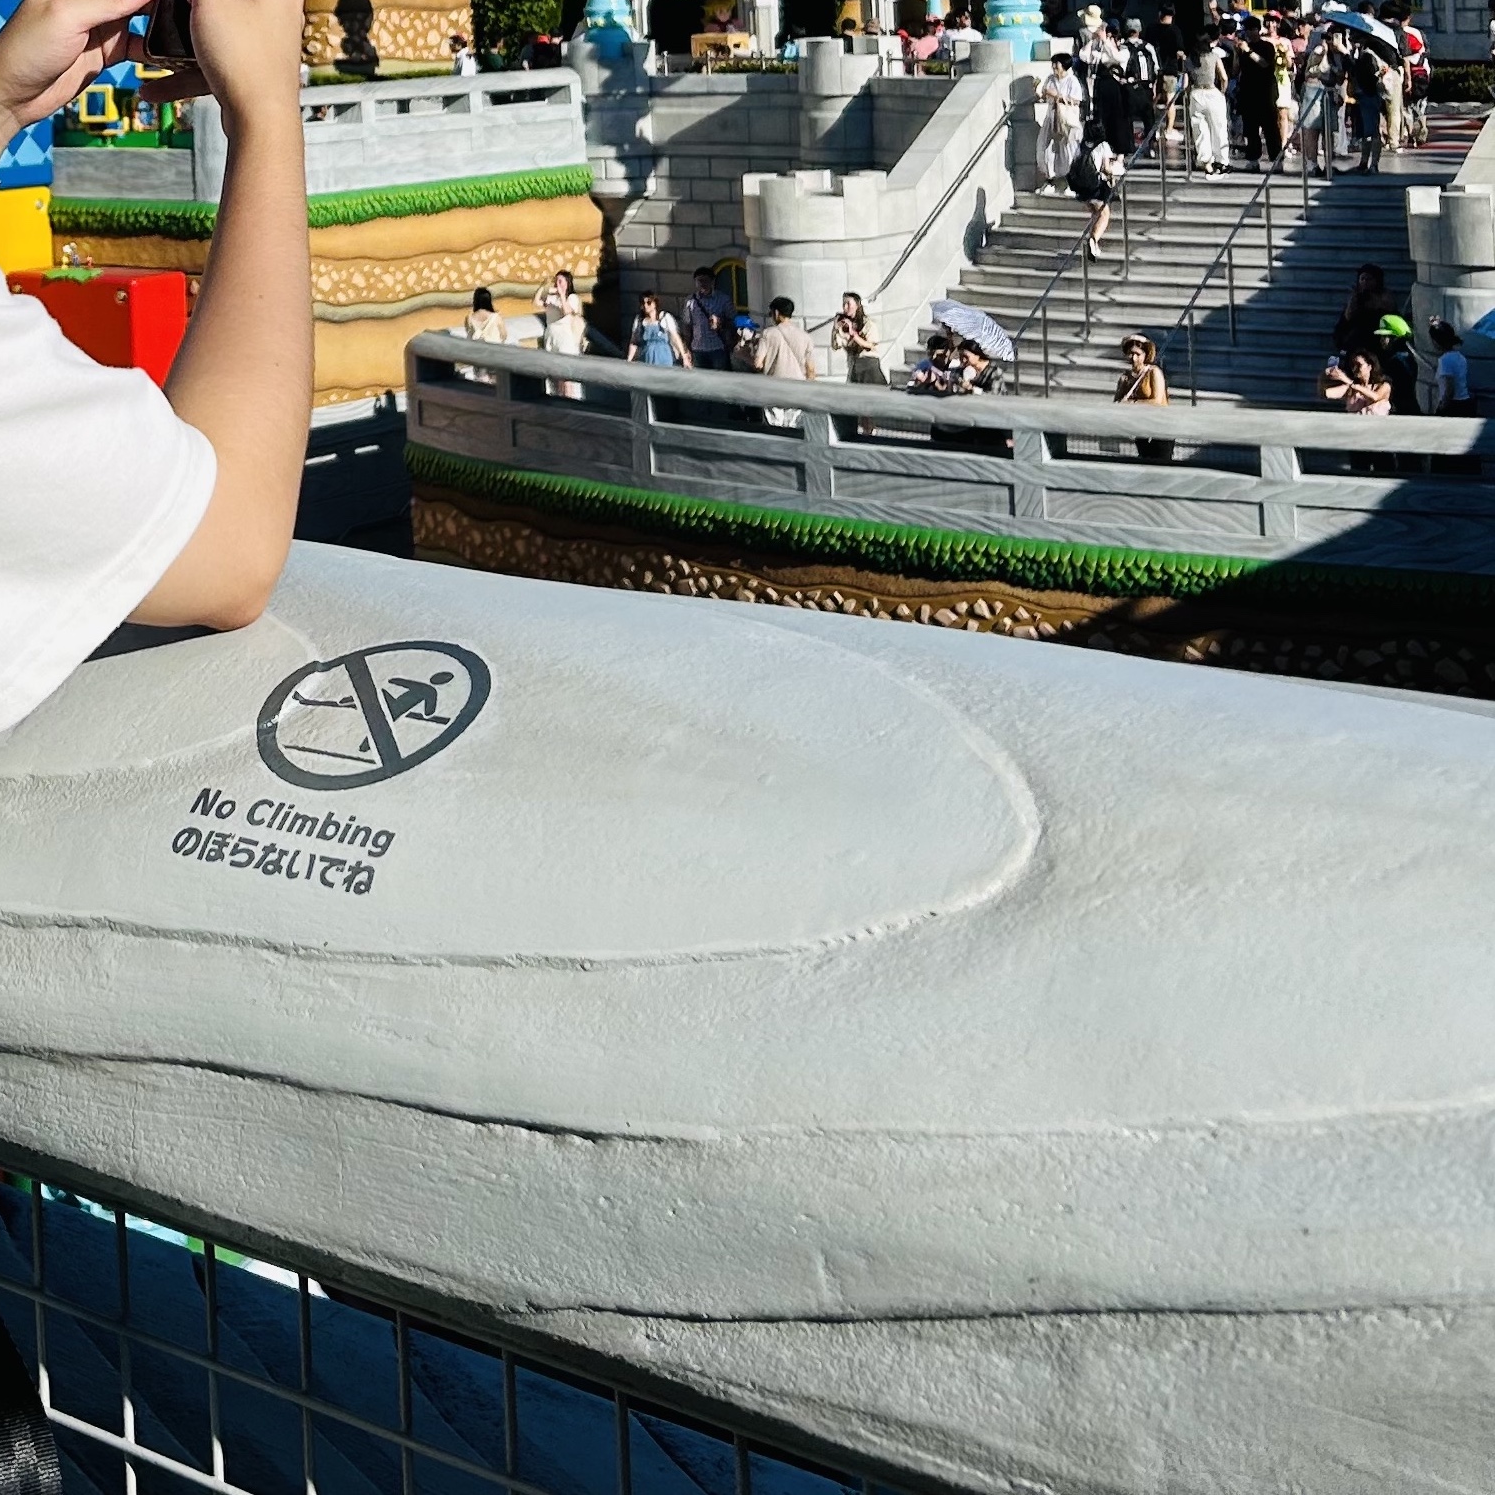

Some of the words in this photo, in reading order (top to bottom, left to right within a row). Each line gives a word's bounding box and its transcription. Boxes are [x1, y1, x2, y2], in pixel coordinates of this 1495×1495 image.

[190, 787, 236, 821] No
[246, 798, 396, 858] Climbing
[171, 826, 376, 896] のぼらないでね
